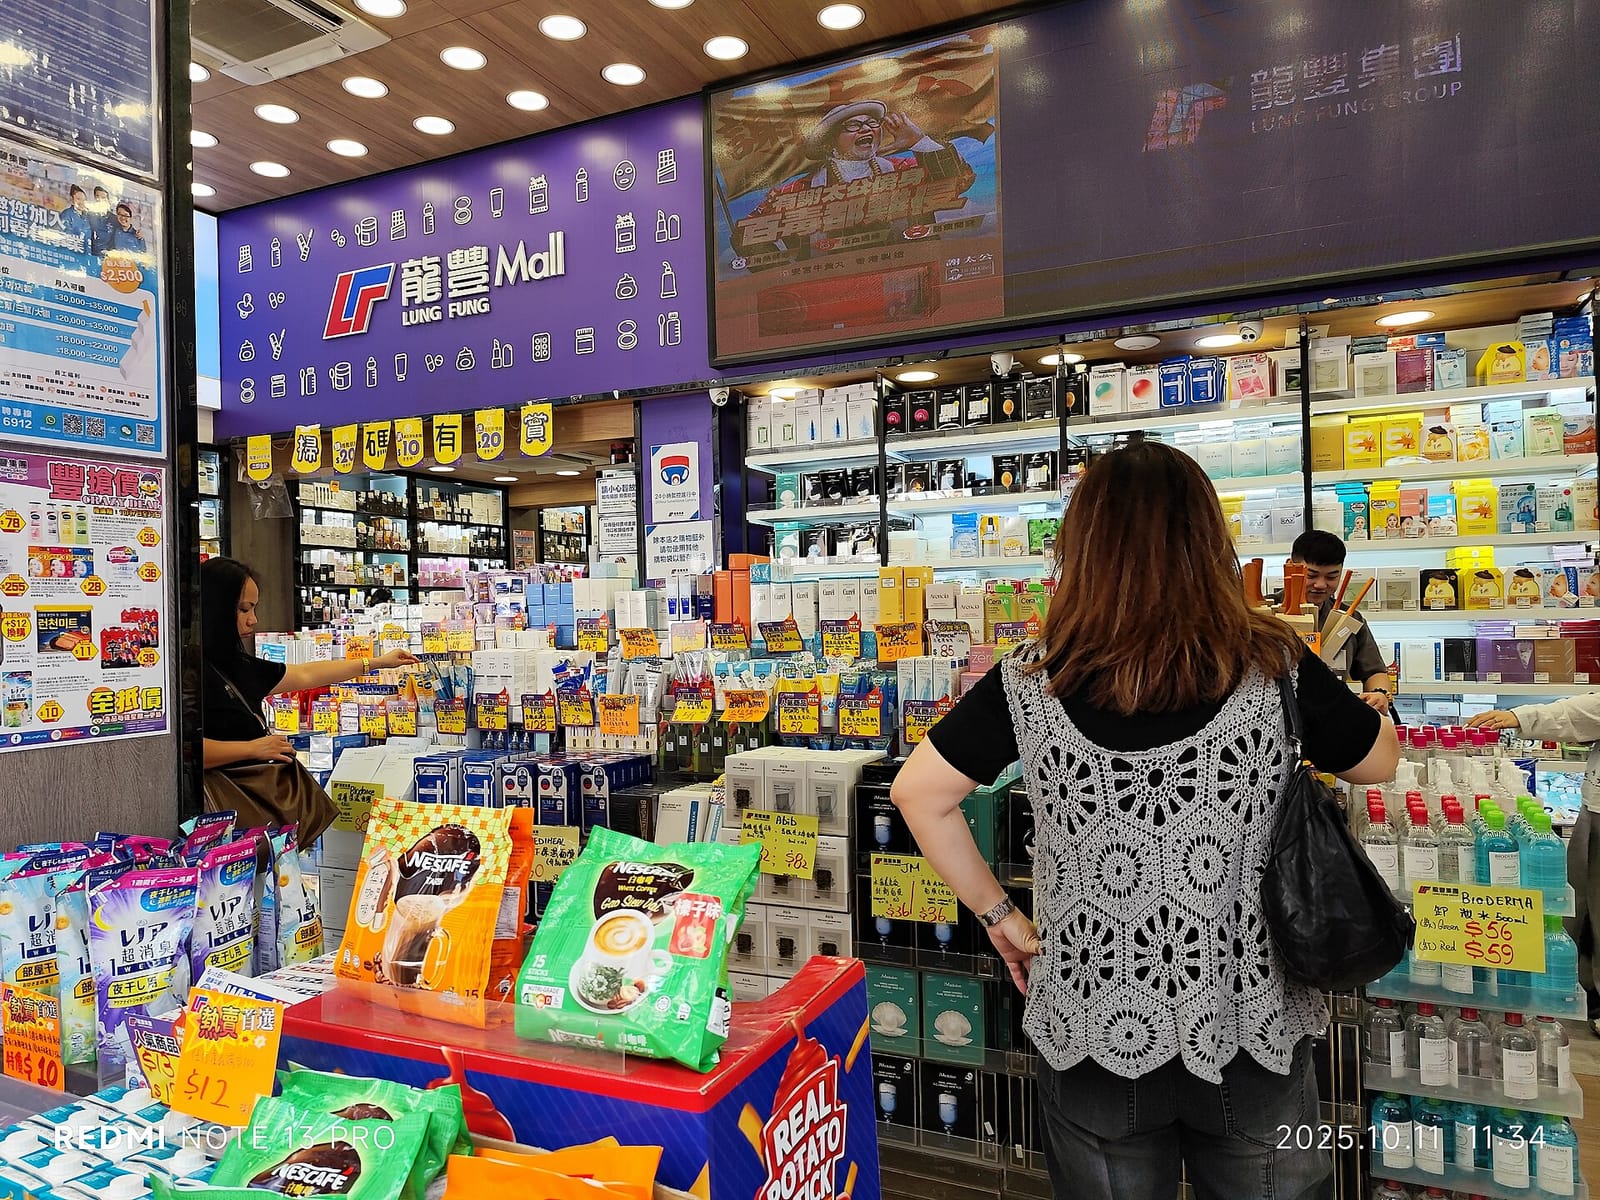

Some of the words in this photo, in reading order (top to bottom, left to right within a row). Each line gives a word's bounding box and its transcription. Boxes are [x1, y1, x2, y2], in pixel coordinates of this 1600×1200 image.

[1387, 81, 1463, 108] GROUP
[494, 231, 565, 287] Mall
[402, 305, 442, 326] LUNG
[448, 297, 490, 319] FUNG
[3, 417, 32, 429] 6912
[297, 435, 319, 463] 掃
[365, 429, 389, 458] 碼
[435, 423, 458, 452] 有
[478, 432, 502, 449] $20
[48, 462, 141, 501] 豐搶價
[775, 815, 797, 827] Abib
[532, 837, 566, 847] EDIHEAL
[29, 911, 56, 932] レノ
[1464, 921, 1513, 942] $56
[121, 941, 174, 964] 超消臭
[532, 954, 547, 969] 15
[1440, 940, 1457, 951] Red
[1464, 939, 1514, 965] $59
[464, 989, 479, 999] 15
[198, 1005, 276, 1042] 熱賣首選
[134, 1030, 180, 1054] 人氣商品
[184, 1068, 230, 1109] $12
[773, 1080, 832, 1167] REAL
[766, 1116, 841, 1200] POTATO
[793, 1158, 832, 1200] TICK
